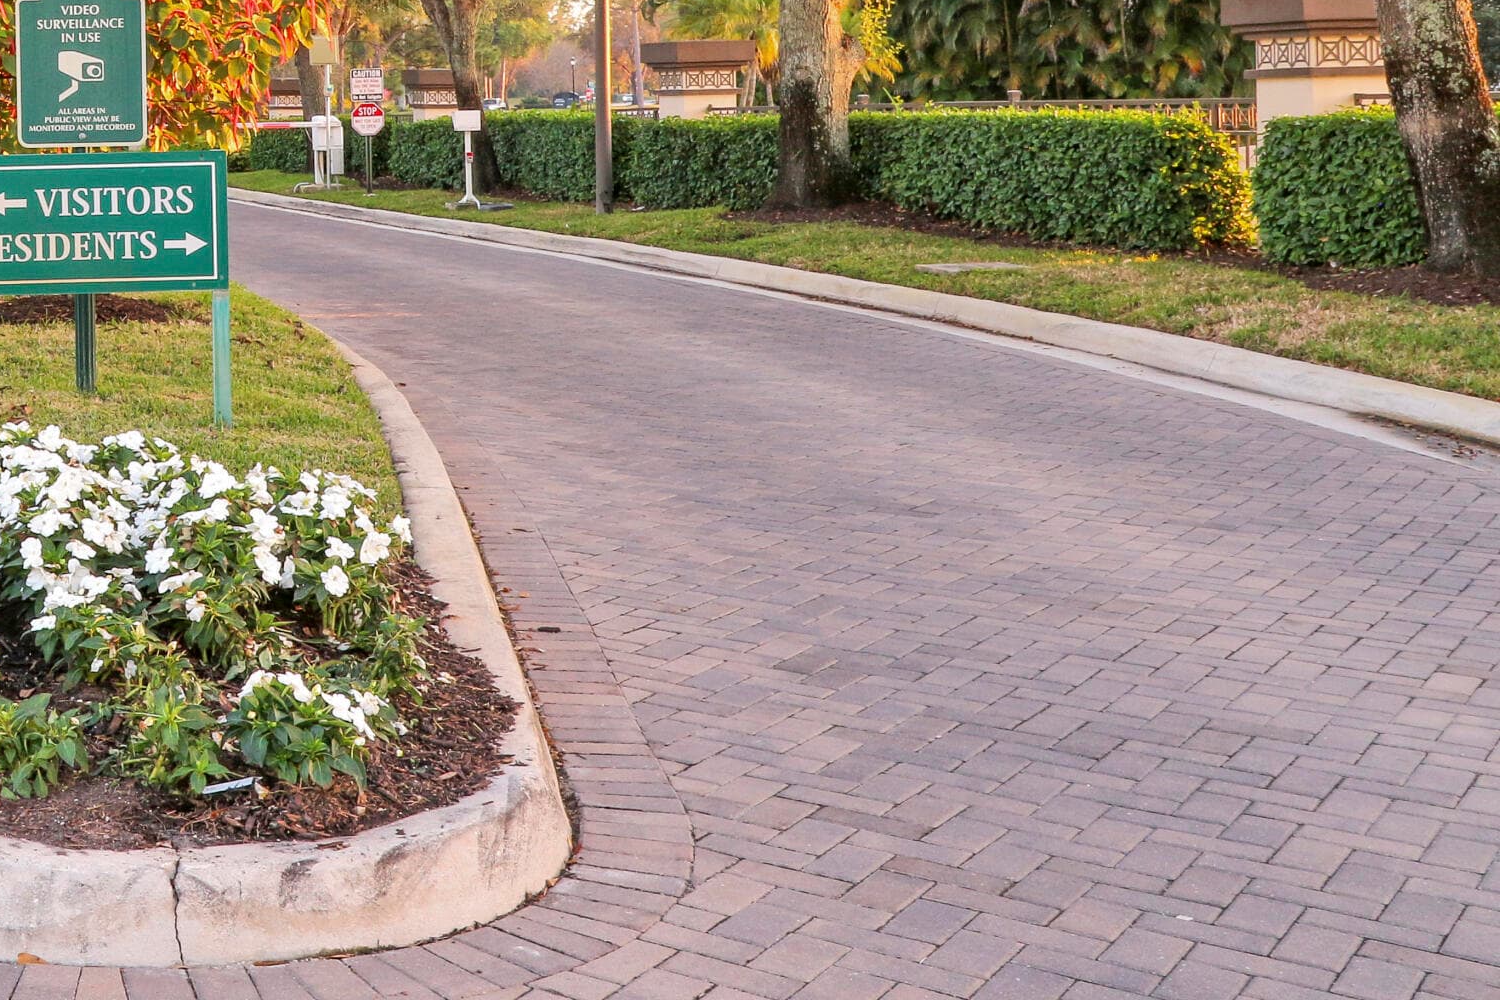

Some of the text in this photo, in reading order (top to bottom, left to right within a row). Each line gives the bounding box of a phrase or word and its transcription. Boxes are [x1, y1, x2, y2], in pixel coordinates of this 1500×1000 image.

[60, 5, 100, 16] VIDEO
[36, 18, 125, 30] SURVEILLANCE
[61, 32, 101, 43] IN USE
[352, 70, 381, 78] CAUTION
[73, 107, 96, 115] AREAS
[358, 106, 378, 116] STOP
[28, 124, 76, 132] MONITORED
[95, 123, 136, 131] RECORDED
[34, 185, 194, 217] VISITORS
